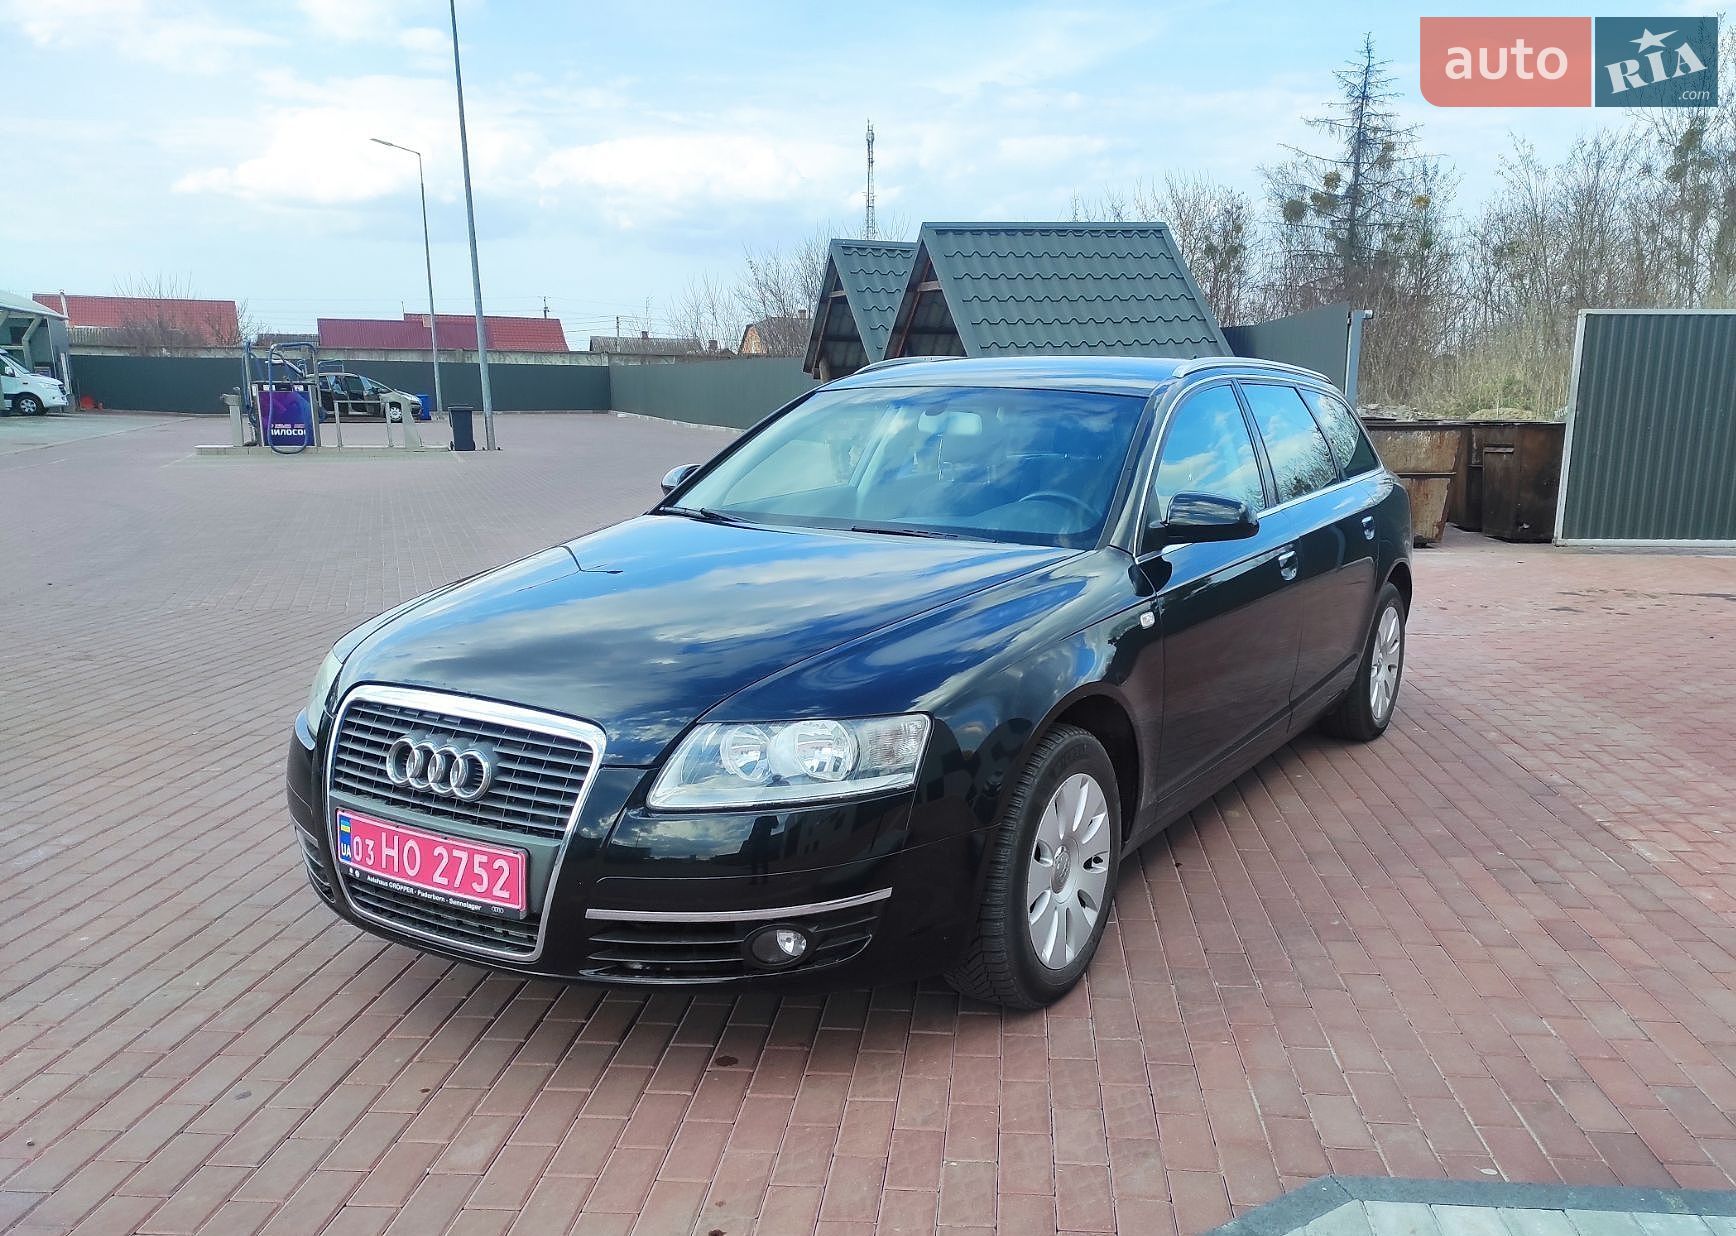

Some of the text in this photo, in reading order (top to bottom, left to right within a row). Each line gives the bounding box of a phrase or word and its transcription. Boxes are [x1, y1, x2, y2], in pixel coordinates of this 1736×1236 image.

[341, 843, 352, 858] UA
[353, 835, 375, 866] 03
[432, 845, 510, 899] 2752
